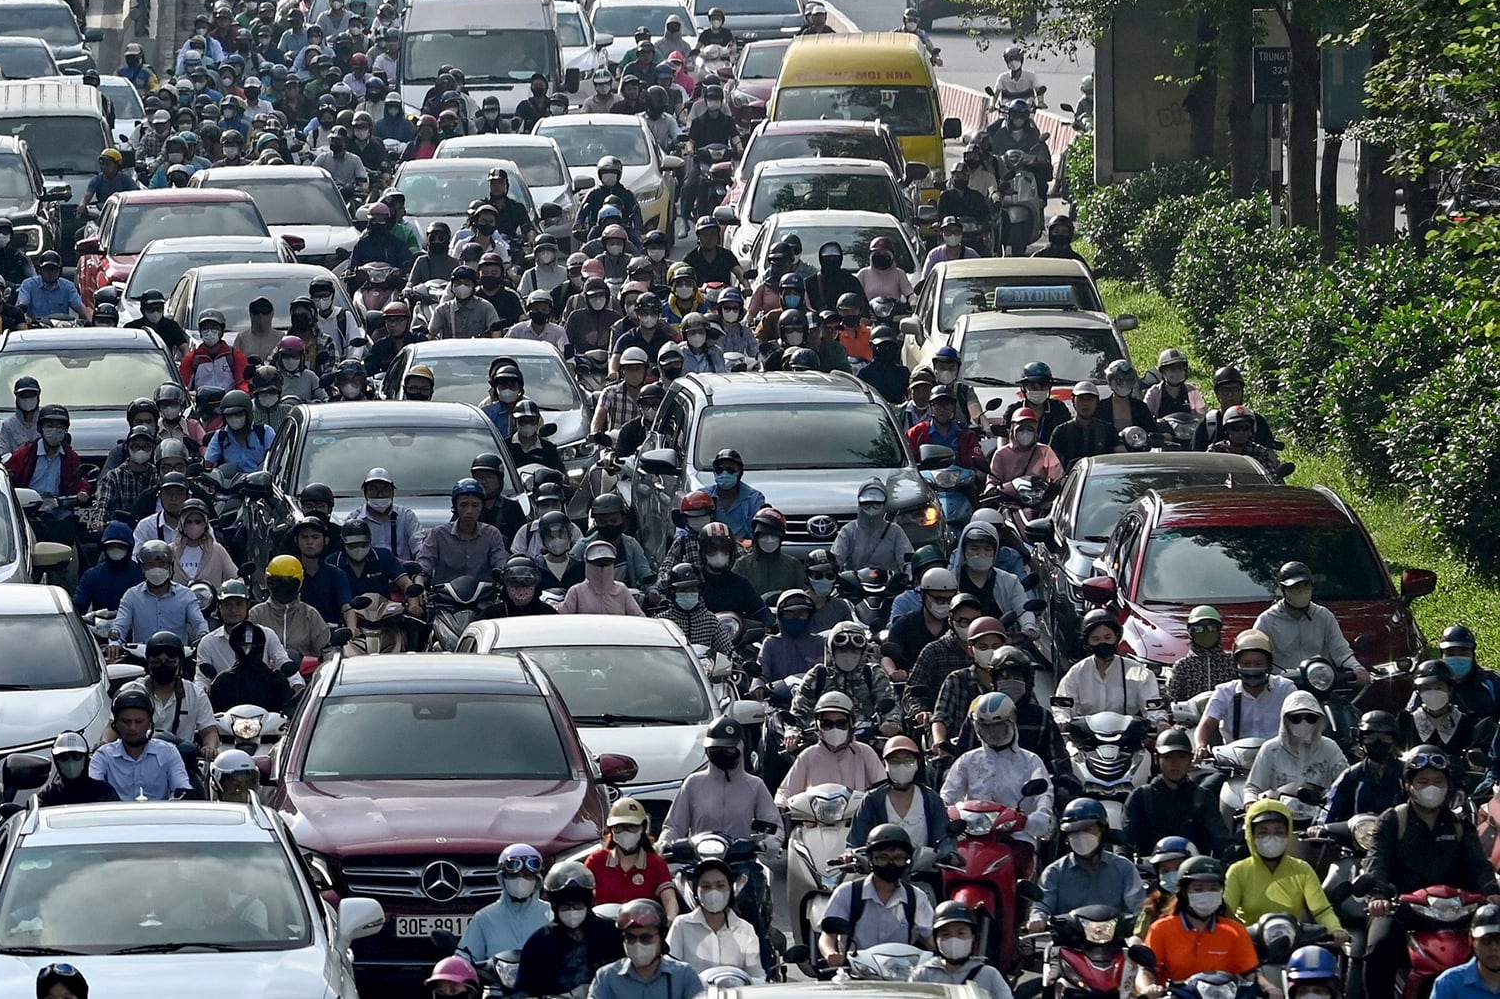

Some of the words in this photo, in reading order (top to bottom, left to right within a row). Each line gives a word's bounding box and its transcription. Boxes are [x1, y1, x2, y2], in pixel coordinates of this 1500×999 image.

[1259, 51, 1285, 61] TRUNG
[1272, 66, 1288, 75] 324
[398, 918, 473, 935] 30E-891
